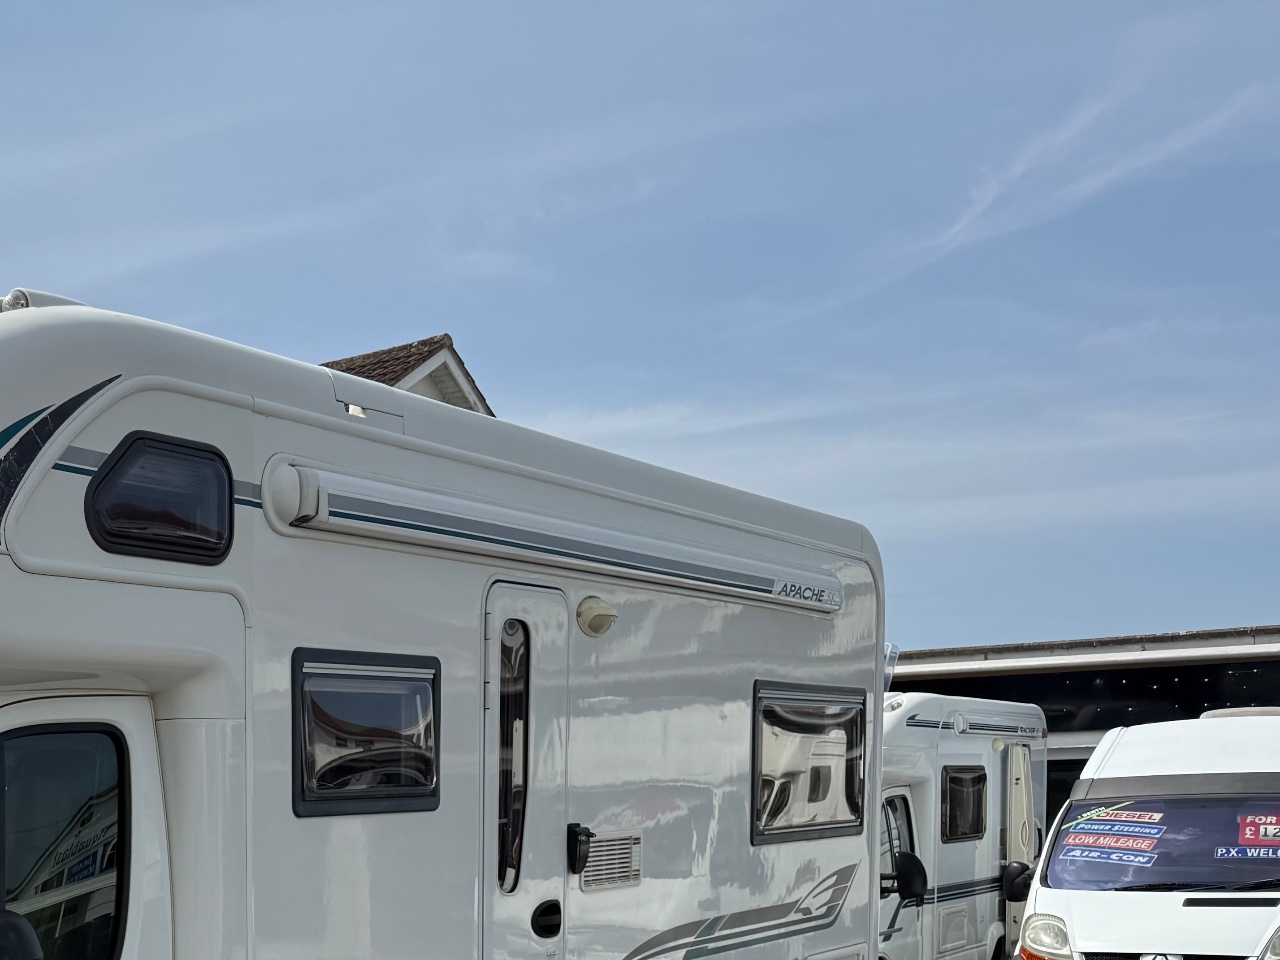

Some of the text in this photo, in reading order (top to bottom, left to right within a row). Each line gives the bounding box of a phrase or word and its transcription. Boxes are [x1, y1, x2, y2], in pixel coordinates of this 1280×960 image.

[778, 582, 826, 603] APACHE
[1097, 812, 1158, 821] DIESEL
[1246, 815, 1277, 824] FOR
[1076, 823, 1159, 834] POWER STEERING
[1068, 835, 1153, 849] LOW MILEAGE
[1217, 848, 1242, 857] P.X.
